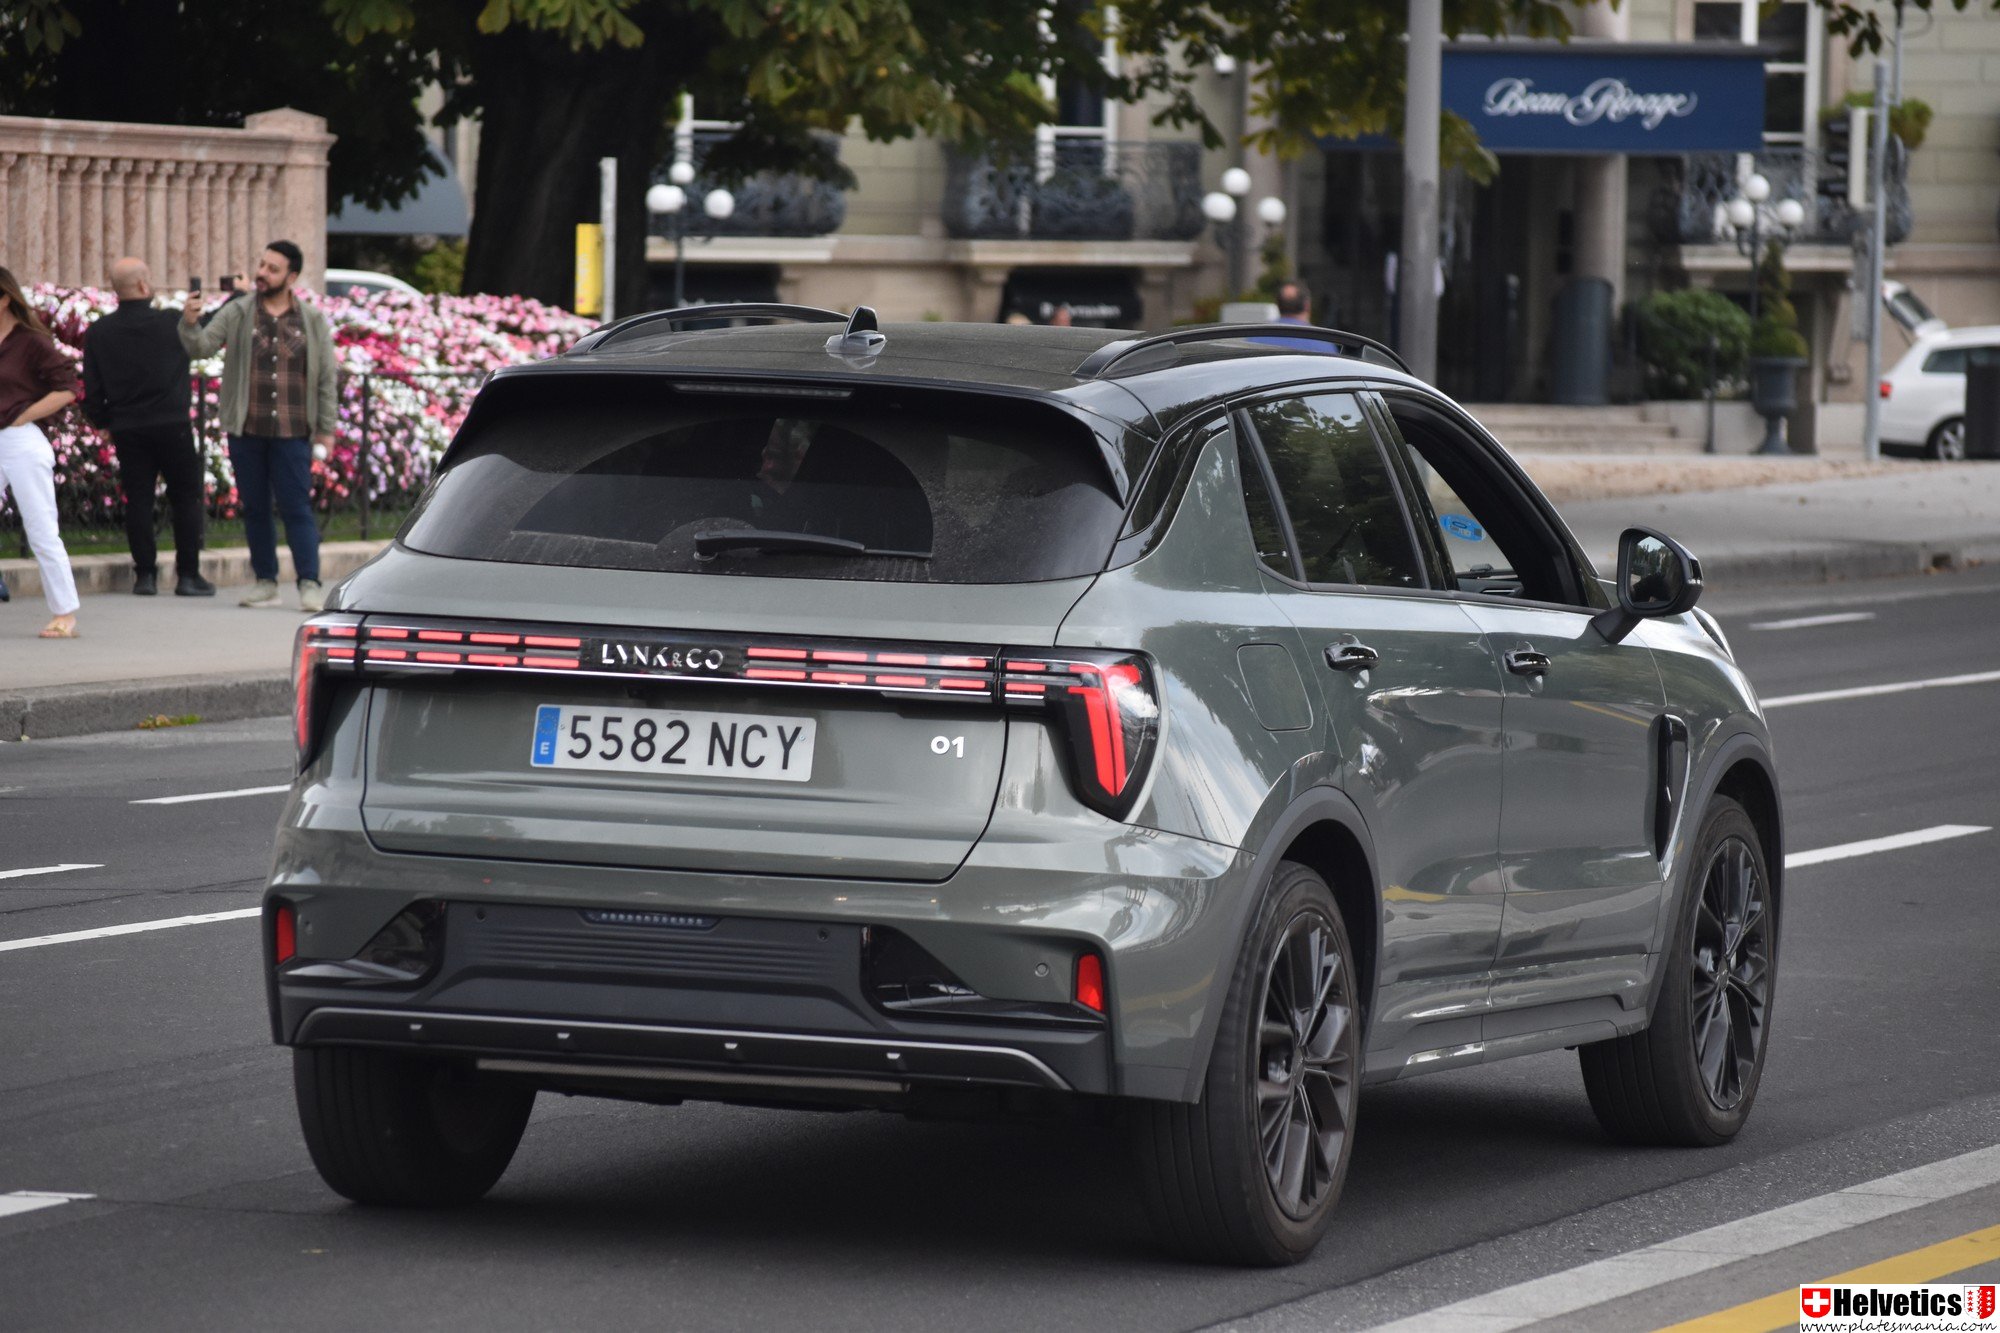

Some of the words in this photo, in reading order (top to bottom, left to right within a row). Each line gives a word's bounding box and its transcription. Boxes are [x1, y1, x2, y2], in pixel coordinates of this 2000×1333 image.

[1482, 77, 1568, 117] Beau
[1564, 77, 1698, 131] Rivage
[541, 742, 550, 755] E
[567, 715, 690, 765] 5582
[707, 721, 803, 771] NCY
[931, 735, 965, 758] 01
